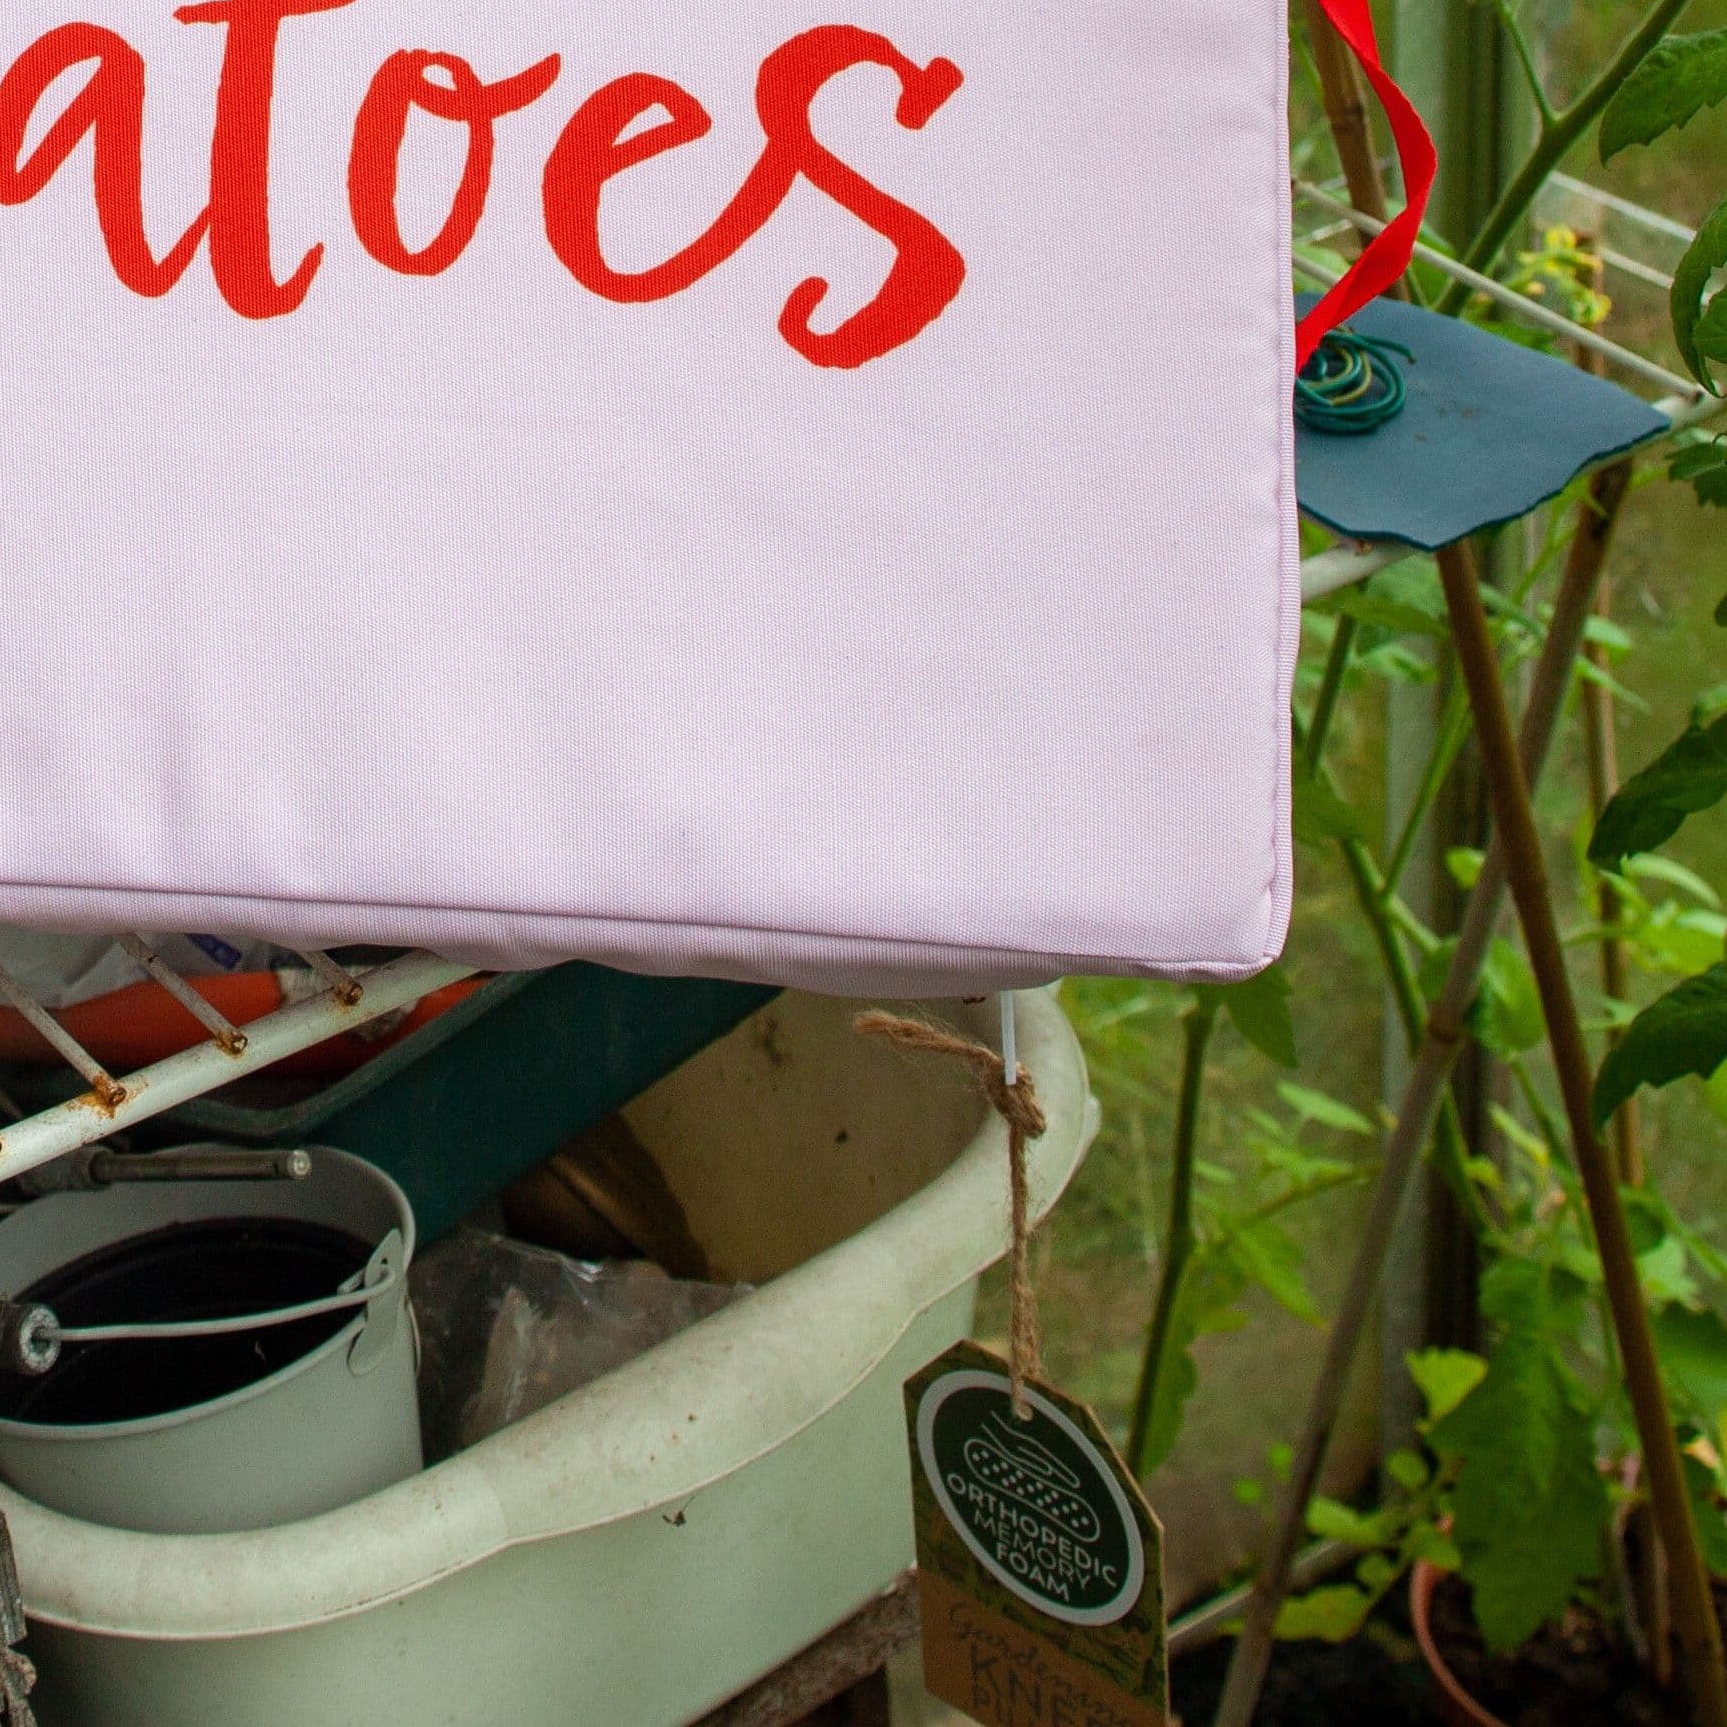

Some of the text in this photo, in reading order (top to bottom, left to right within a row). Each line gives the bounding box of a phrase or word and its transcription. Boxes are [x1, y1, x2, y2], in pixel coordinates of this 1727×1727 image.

[947, 1472, 1117, 1589] ORTHOPEDIC
[974, 1508, 1091, 1590] MEMORY
[995, 1542, 1071, 1602] FOAM
